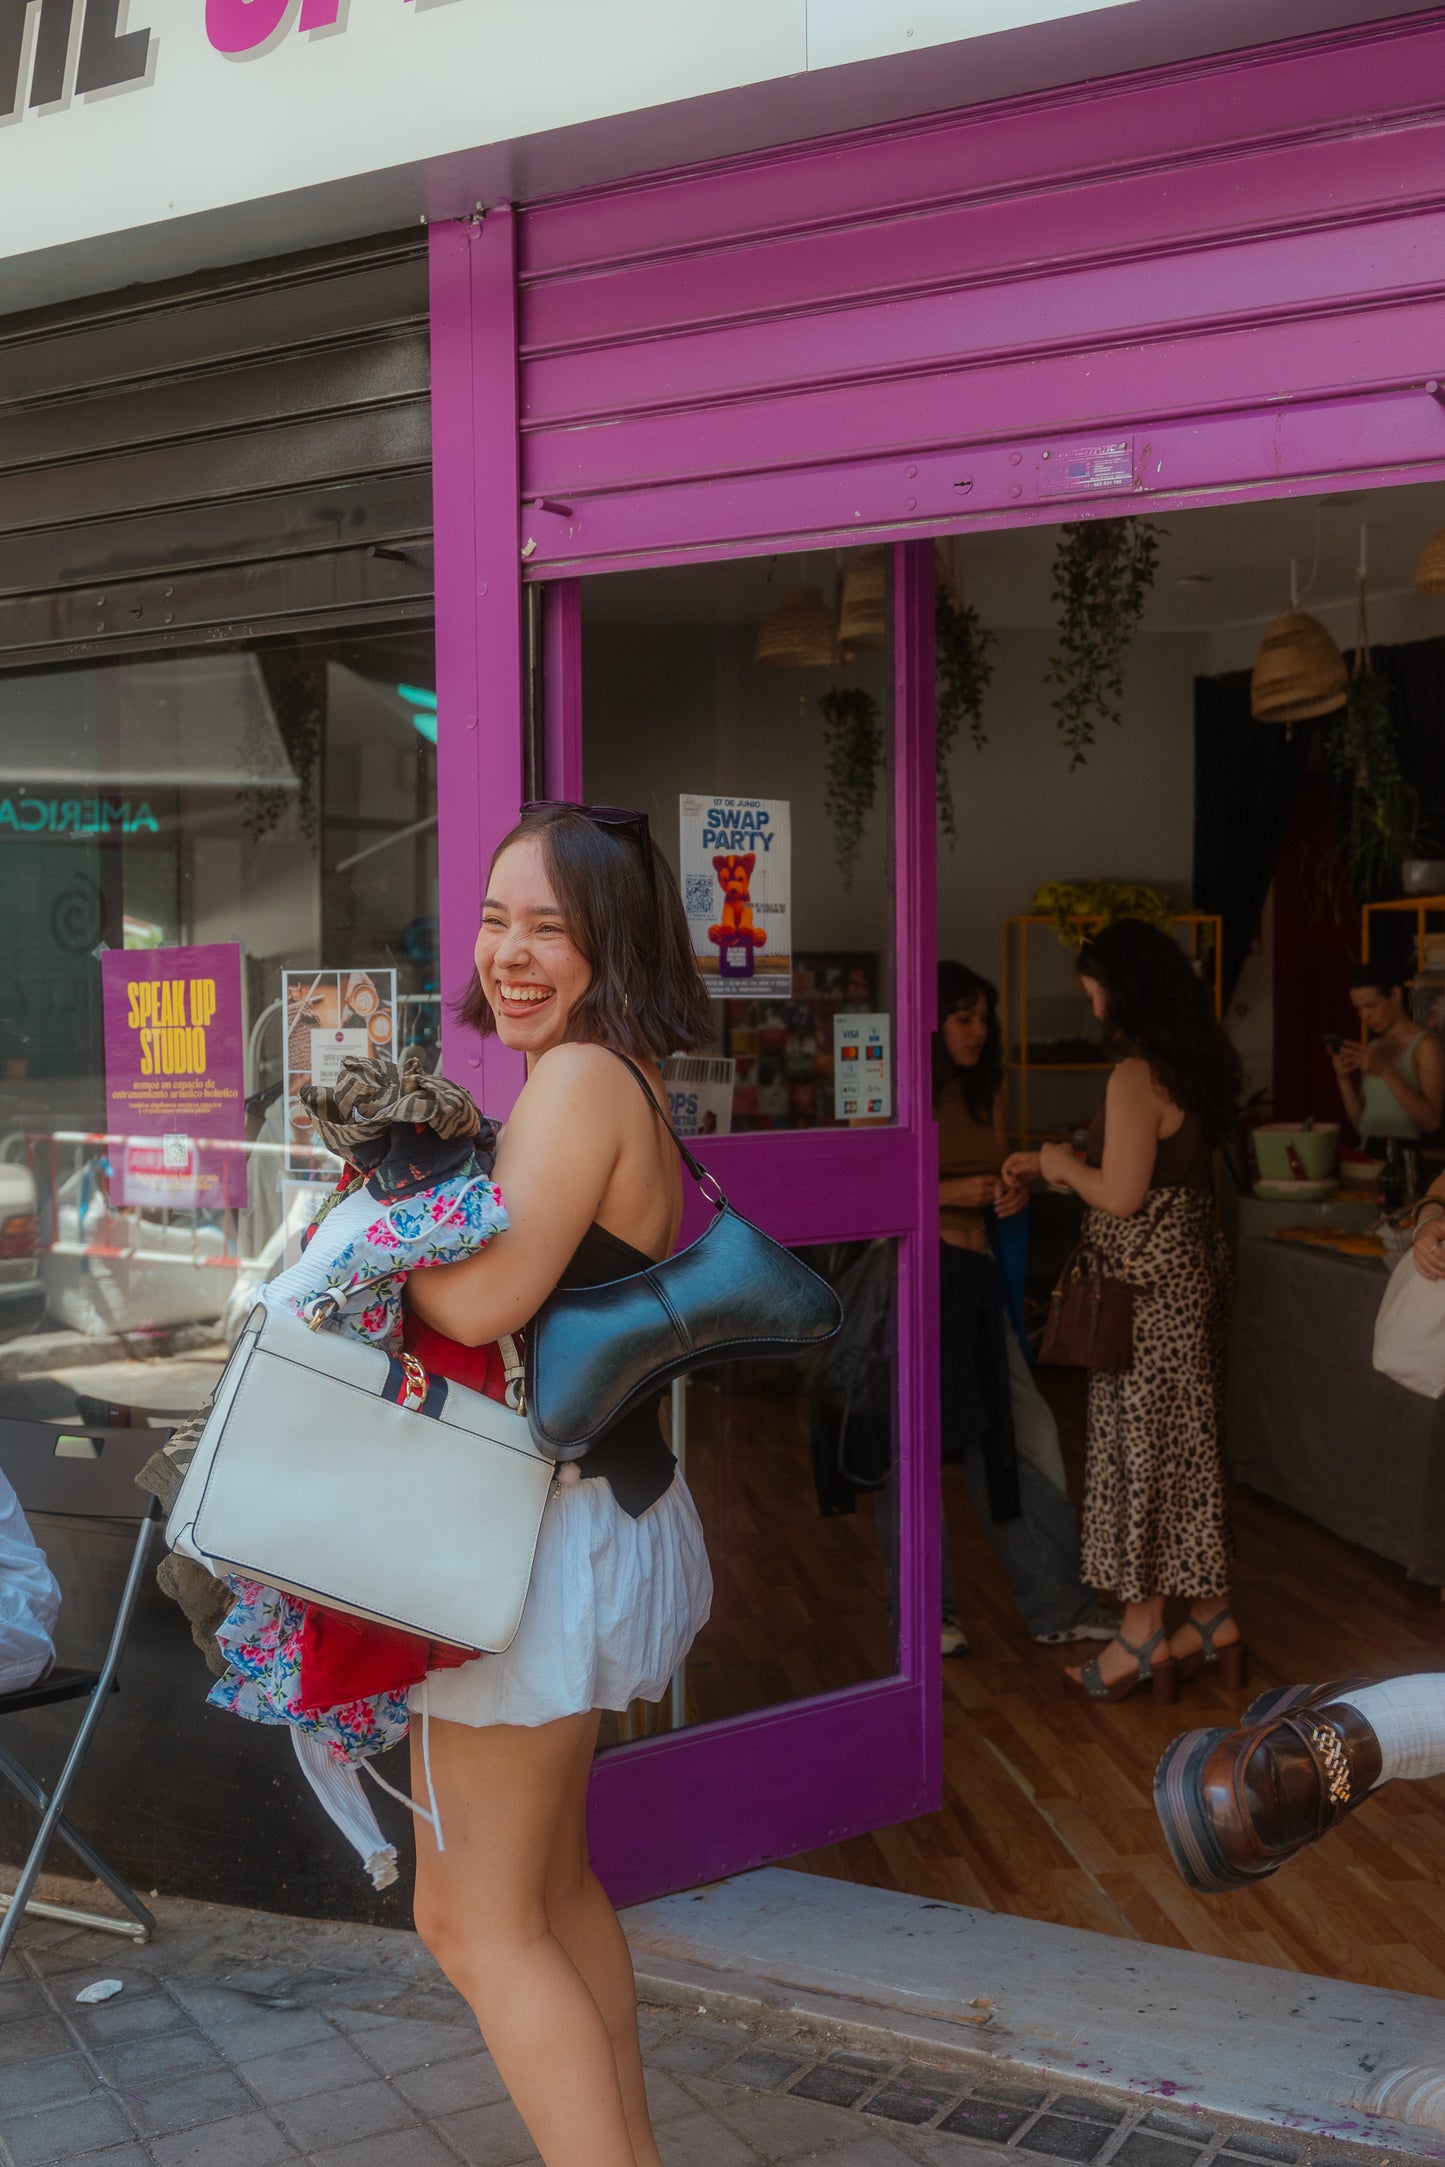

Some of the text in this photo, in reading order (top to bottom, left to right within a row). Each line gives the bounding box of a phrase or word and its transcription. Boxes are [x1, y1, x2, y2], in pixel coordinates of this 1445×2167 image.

[713, 798, 722, 806] 07
[736, 799, 761, 808] JUNIO
[707, 808, 769, 830] SWAP
[702, 829, 774, 852] PARTY
[127, 978, 216, 1029] SPEAK UP
[842, 1030, 859, 1039] VISA
[140, 1027, 207, 1075] STUDIO
[161, 1081, 171, 1089] un
[205, 1078, 215, 1089] de
[112, 1089, 168, 1099] entrenamiento
